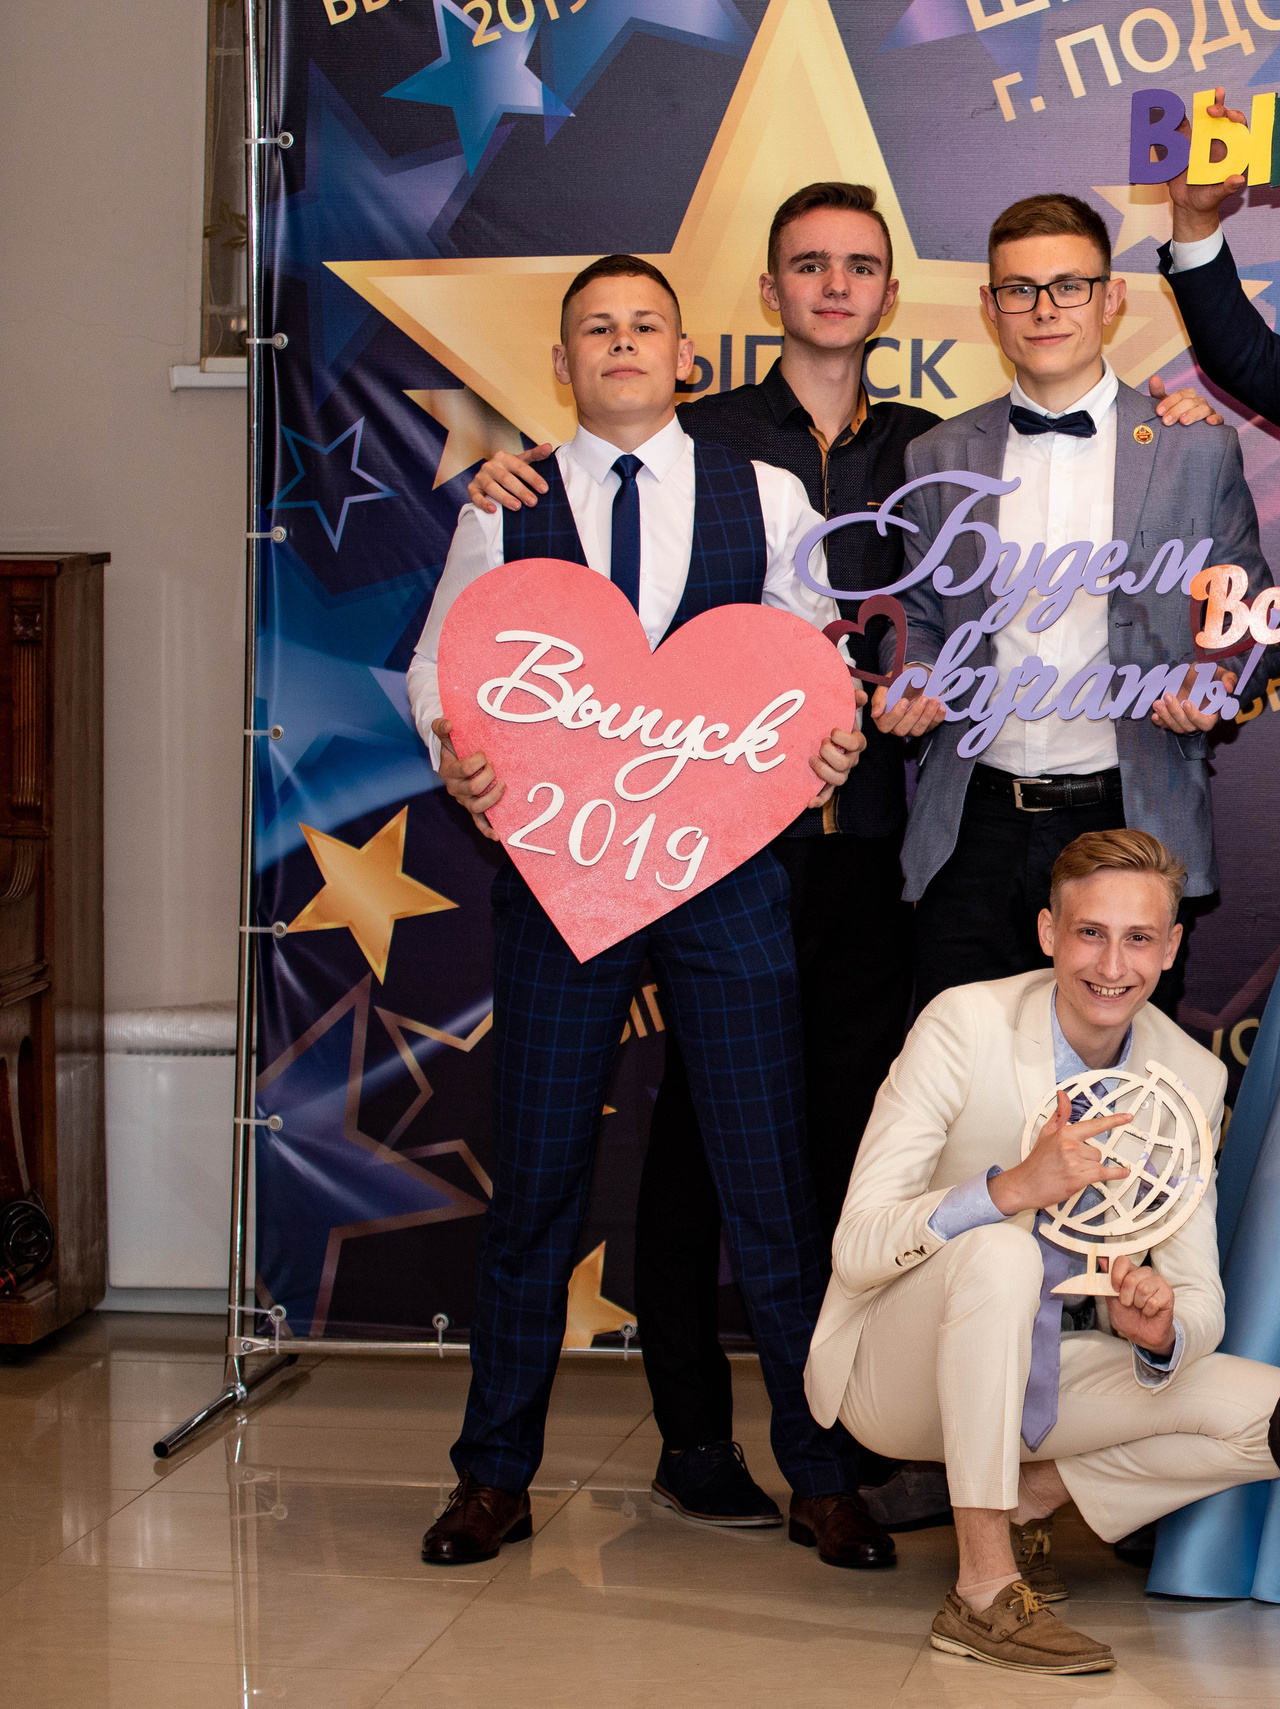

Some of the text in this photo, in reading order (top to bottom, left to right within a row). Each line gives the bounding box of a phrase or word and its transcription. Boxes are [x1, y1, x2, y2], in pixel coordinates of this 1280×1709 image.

[992, 71, 1046, 122] г.
[795, 470, 1214, 633] Будем
[477, 630, 806, 801] Выпуск
[507, 782, 709, 891] 2019
